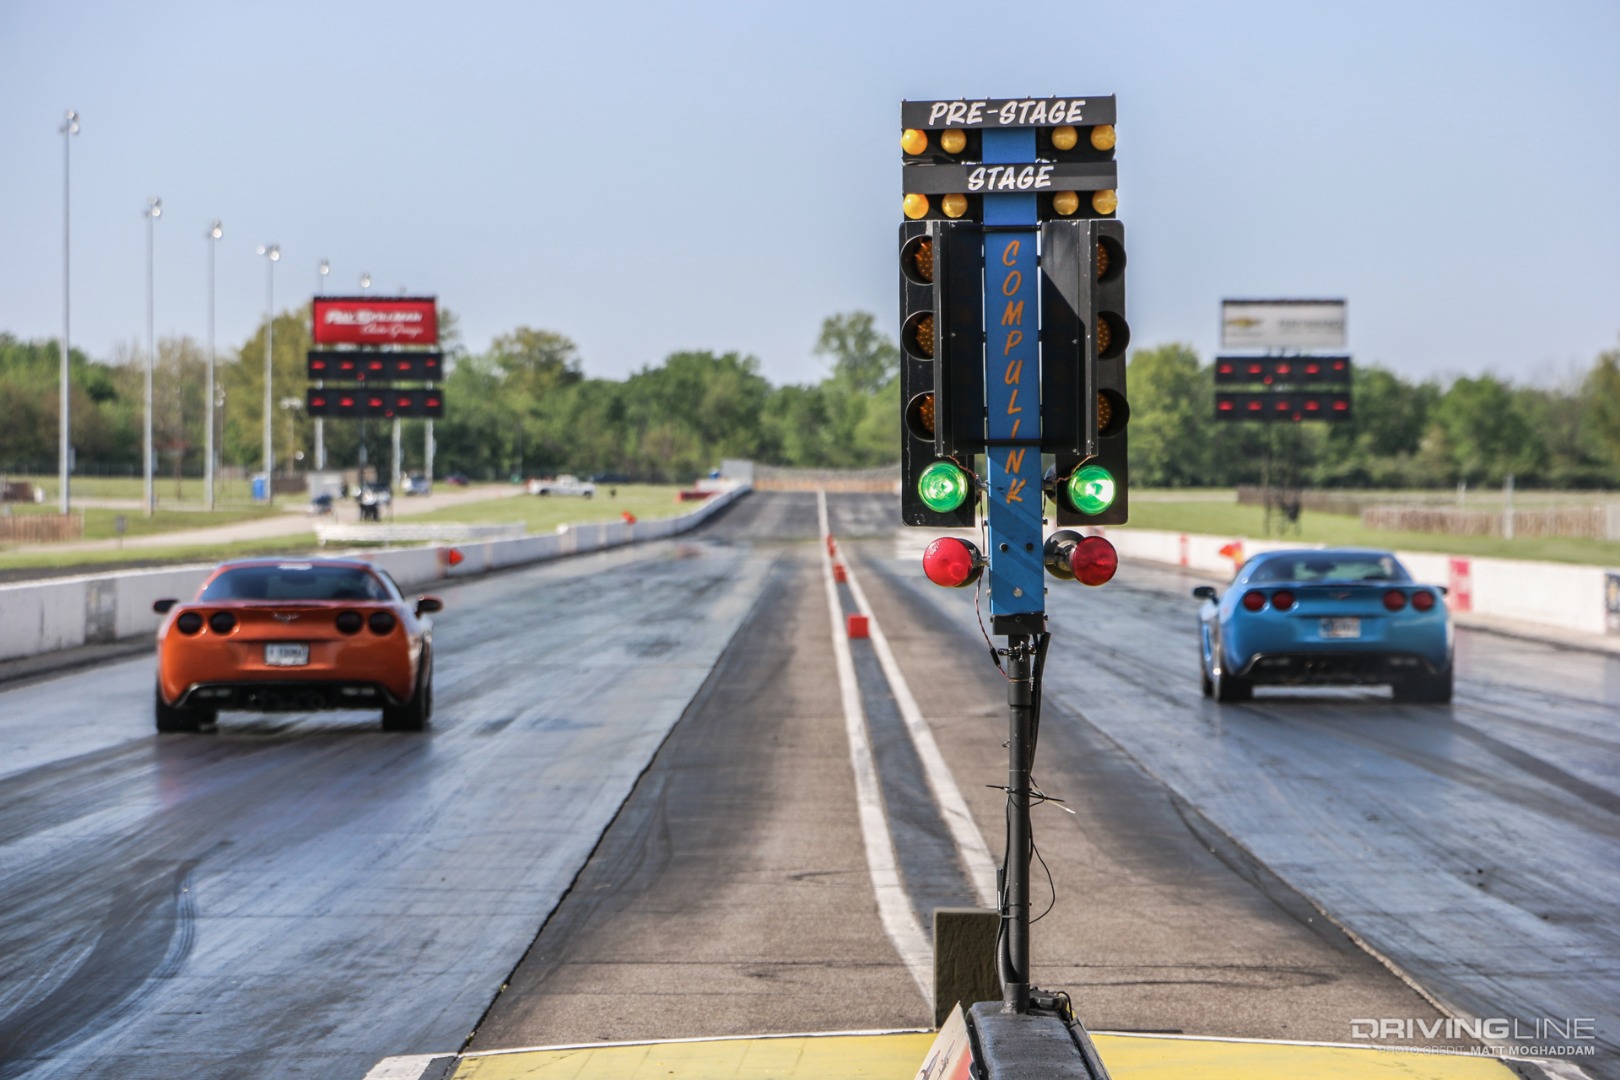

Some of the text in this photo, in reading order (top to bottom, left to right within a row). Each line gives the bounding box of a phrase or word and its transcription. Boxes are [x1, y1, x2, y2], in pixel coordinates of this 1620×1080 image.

[928, 100, 1086, 126] PRE-STAGE
[967, 165, 1054, 191] STAGE
[1001, 239, 1027, 504] COMPULINK
